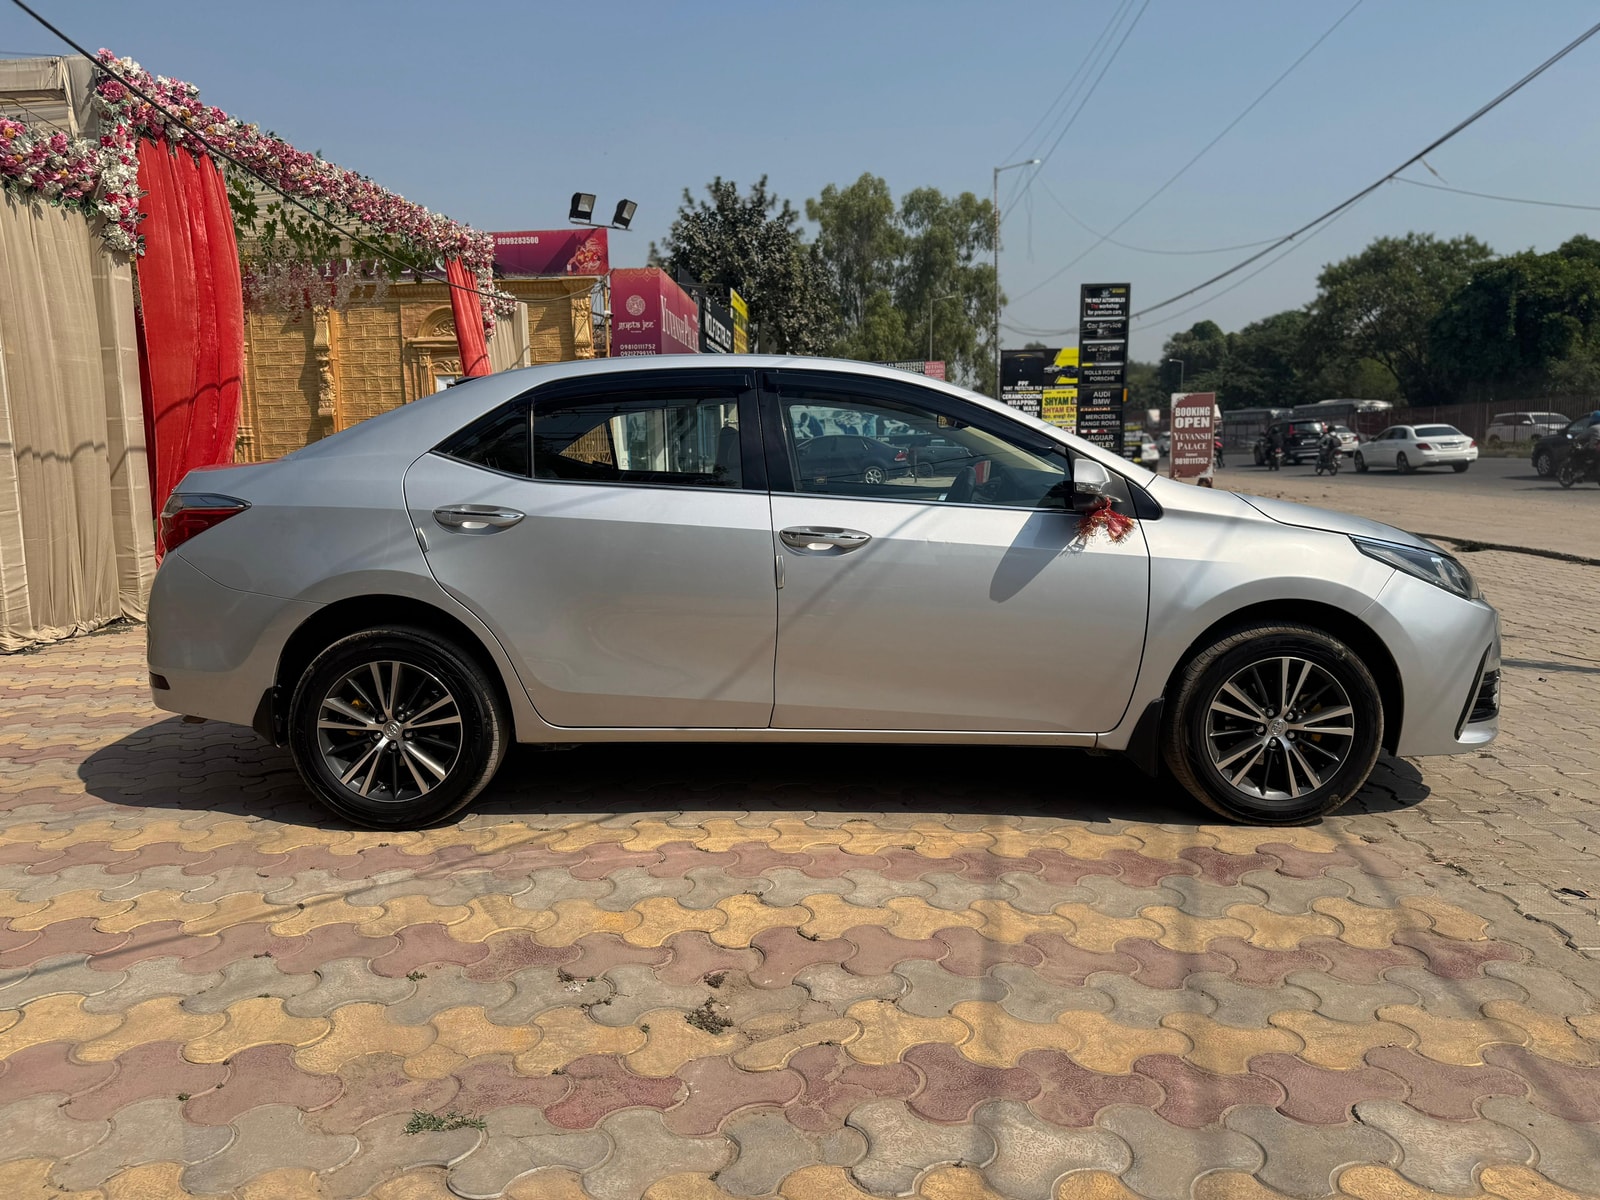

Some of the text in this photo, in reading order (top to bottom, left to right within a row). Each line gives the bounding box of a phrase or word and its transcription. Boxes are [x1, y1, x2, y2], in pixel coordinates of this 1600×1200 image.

[497, 236, 539, 245] 9999283500
[1044, 396, 1068, 406] SHYAM
[1175, 406, 1211, 416] BOOKING
[1174, 417, 1210, 428] OPEN
[1174, 432, 1212, 440] YUVANSH
[1177, 442, 1208, 450] PALACE
[1174, 456, 1208, 464] 9810111752
